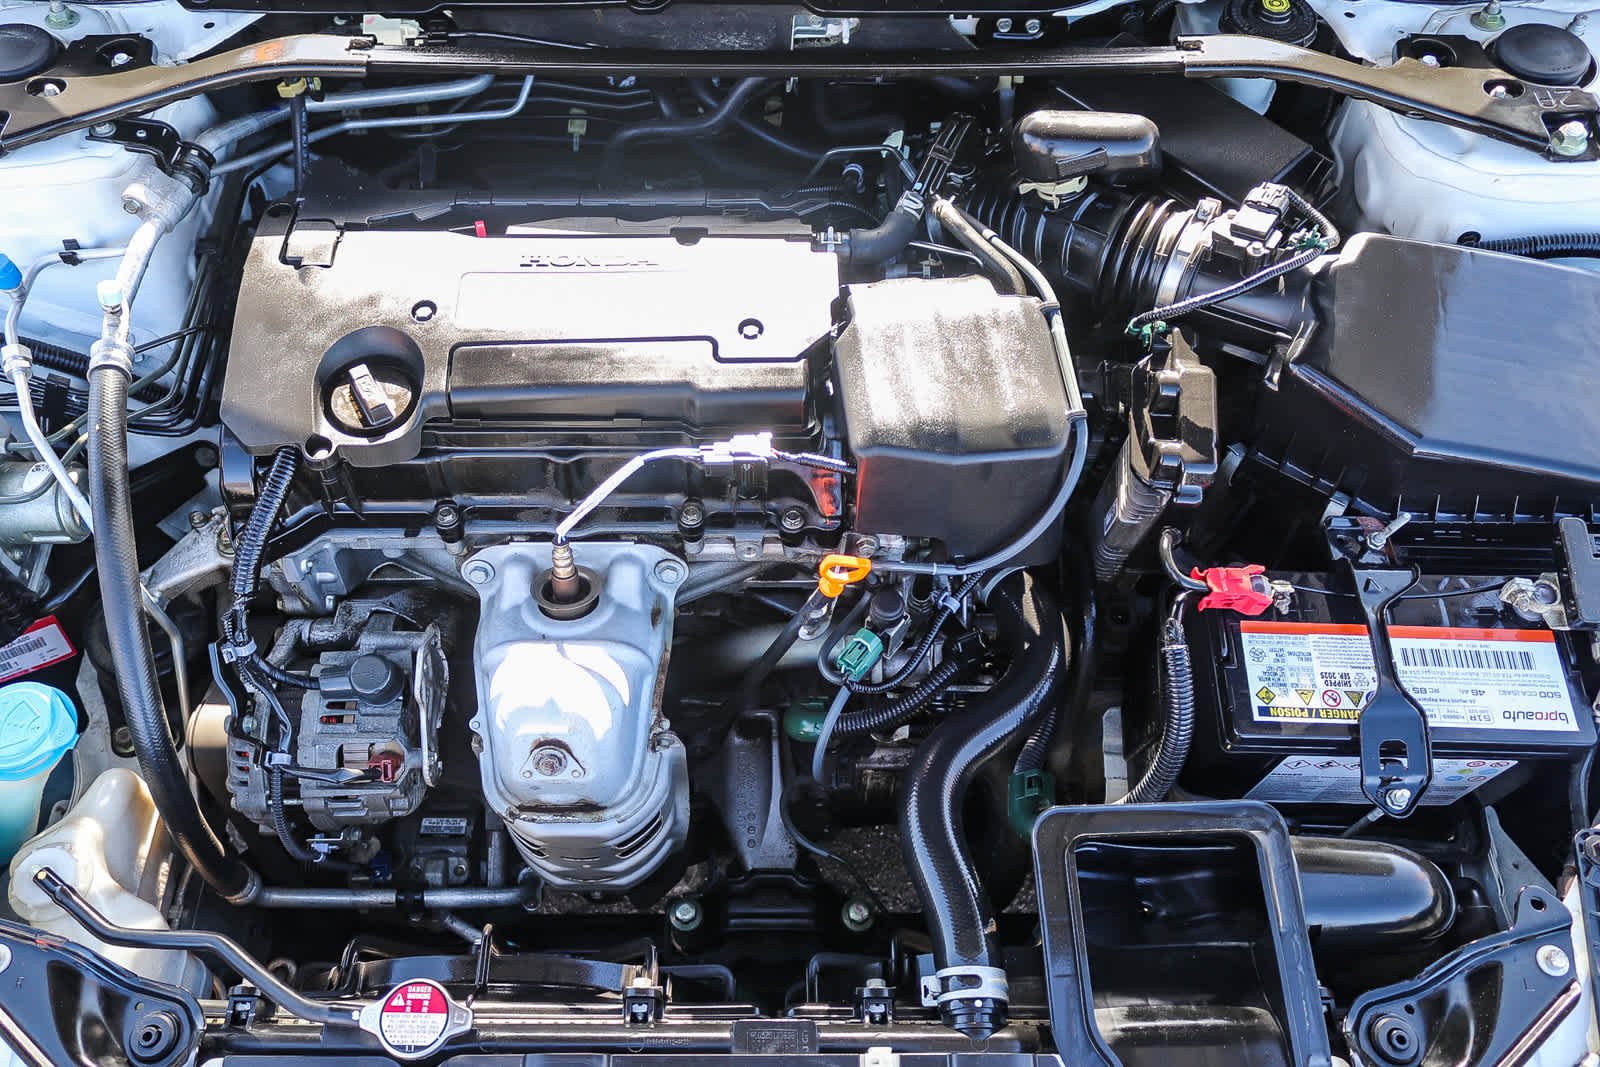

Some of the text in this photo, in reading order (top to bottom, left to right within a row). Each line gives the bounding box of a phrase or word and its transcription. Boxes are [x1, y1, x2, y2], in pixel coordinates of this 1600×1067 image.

[519, 255, 659, 268] HONDA
[1320, 672, 1350, 680] SEP. 2025
[1324, 680, 1352, 688] SHIPPED
[1270, 707, 1309, 718] POISON
[1502, 710, 1569, 724] bproauto
[407, 985, 432, 993] DANGER
